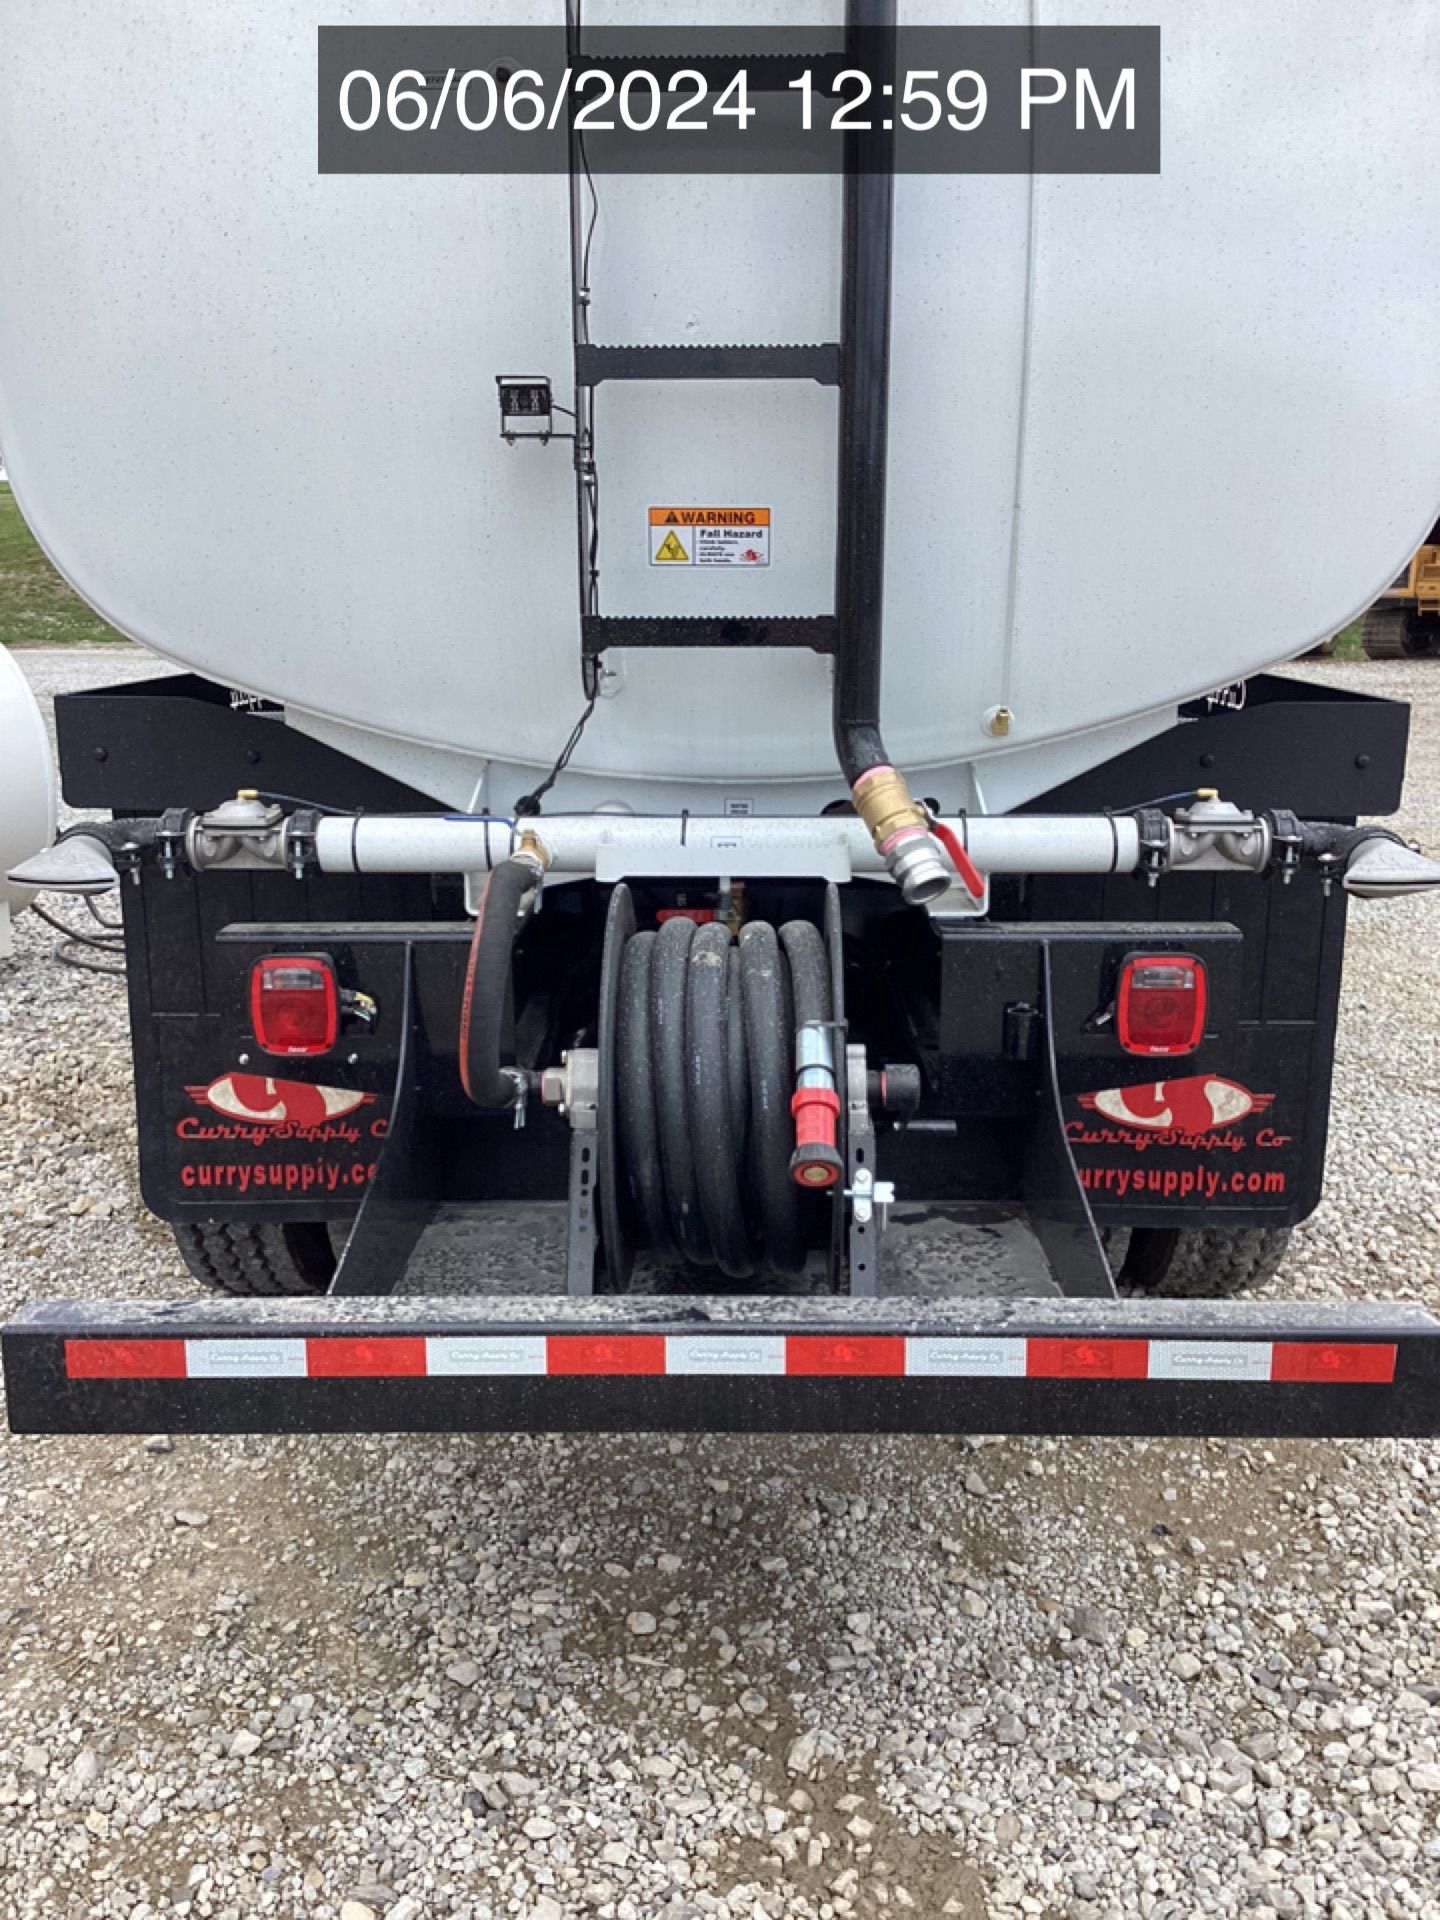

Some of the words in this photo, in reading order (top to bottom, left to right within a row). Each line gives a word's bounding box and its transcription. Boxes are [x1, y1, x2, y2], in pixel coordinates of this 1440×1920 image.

[681, 511, 755, 523] WARNING
[700, 529, 721, 538] Fall
[723, 529, 763, 538] Hazard
[176, 1117, 269, 1147] Curry
[272, 1121, 361, 1143] Supply
[371, 1119, 388, 1137] C
[1064, 1121, 1152, 1151] Curry
[1154, 1129, 1246, 1151] Supply
[1255, 1128, 1292, 1147] Co
[1079, 1165, 1285, 1197] urrysupply.com
